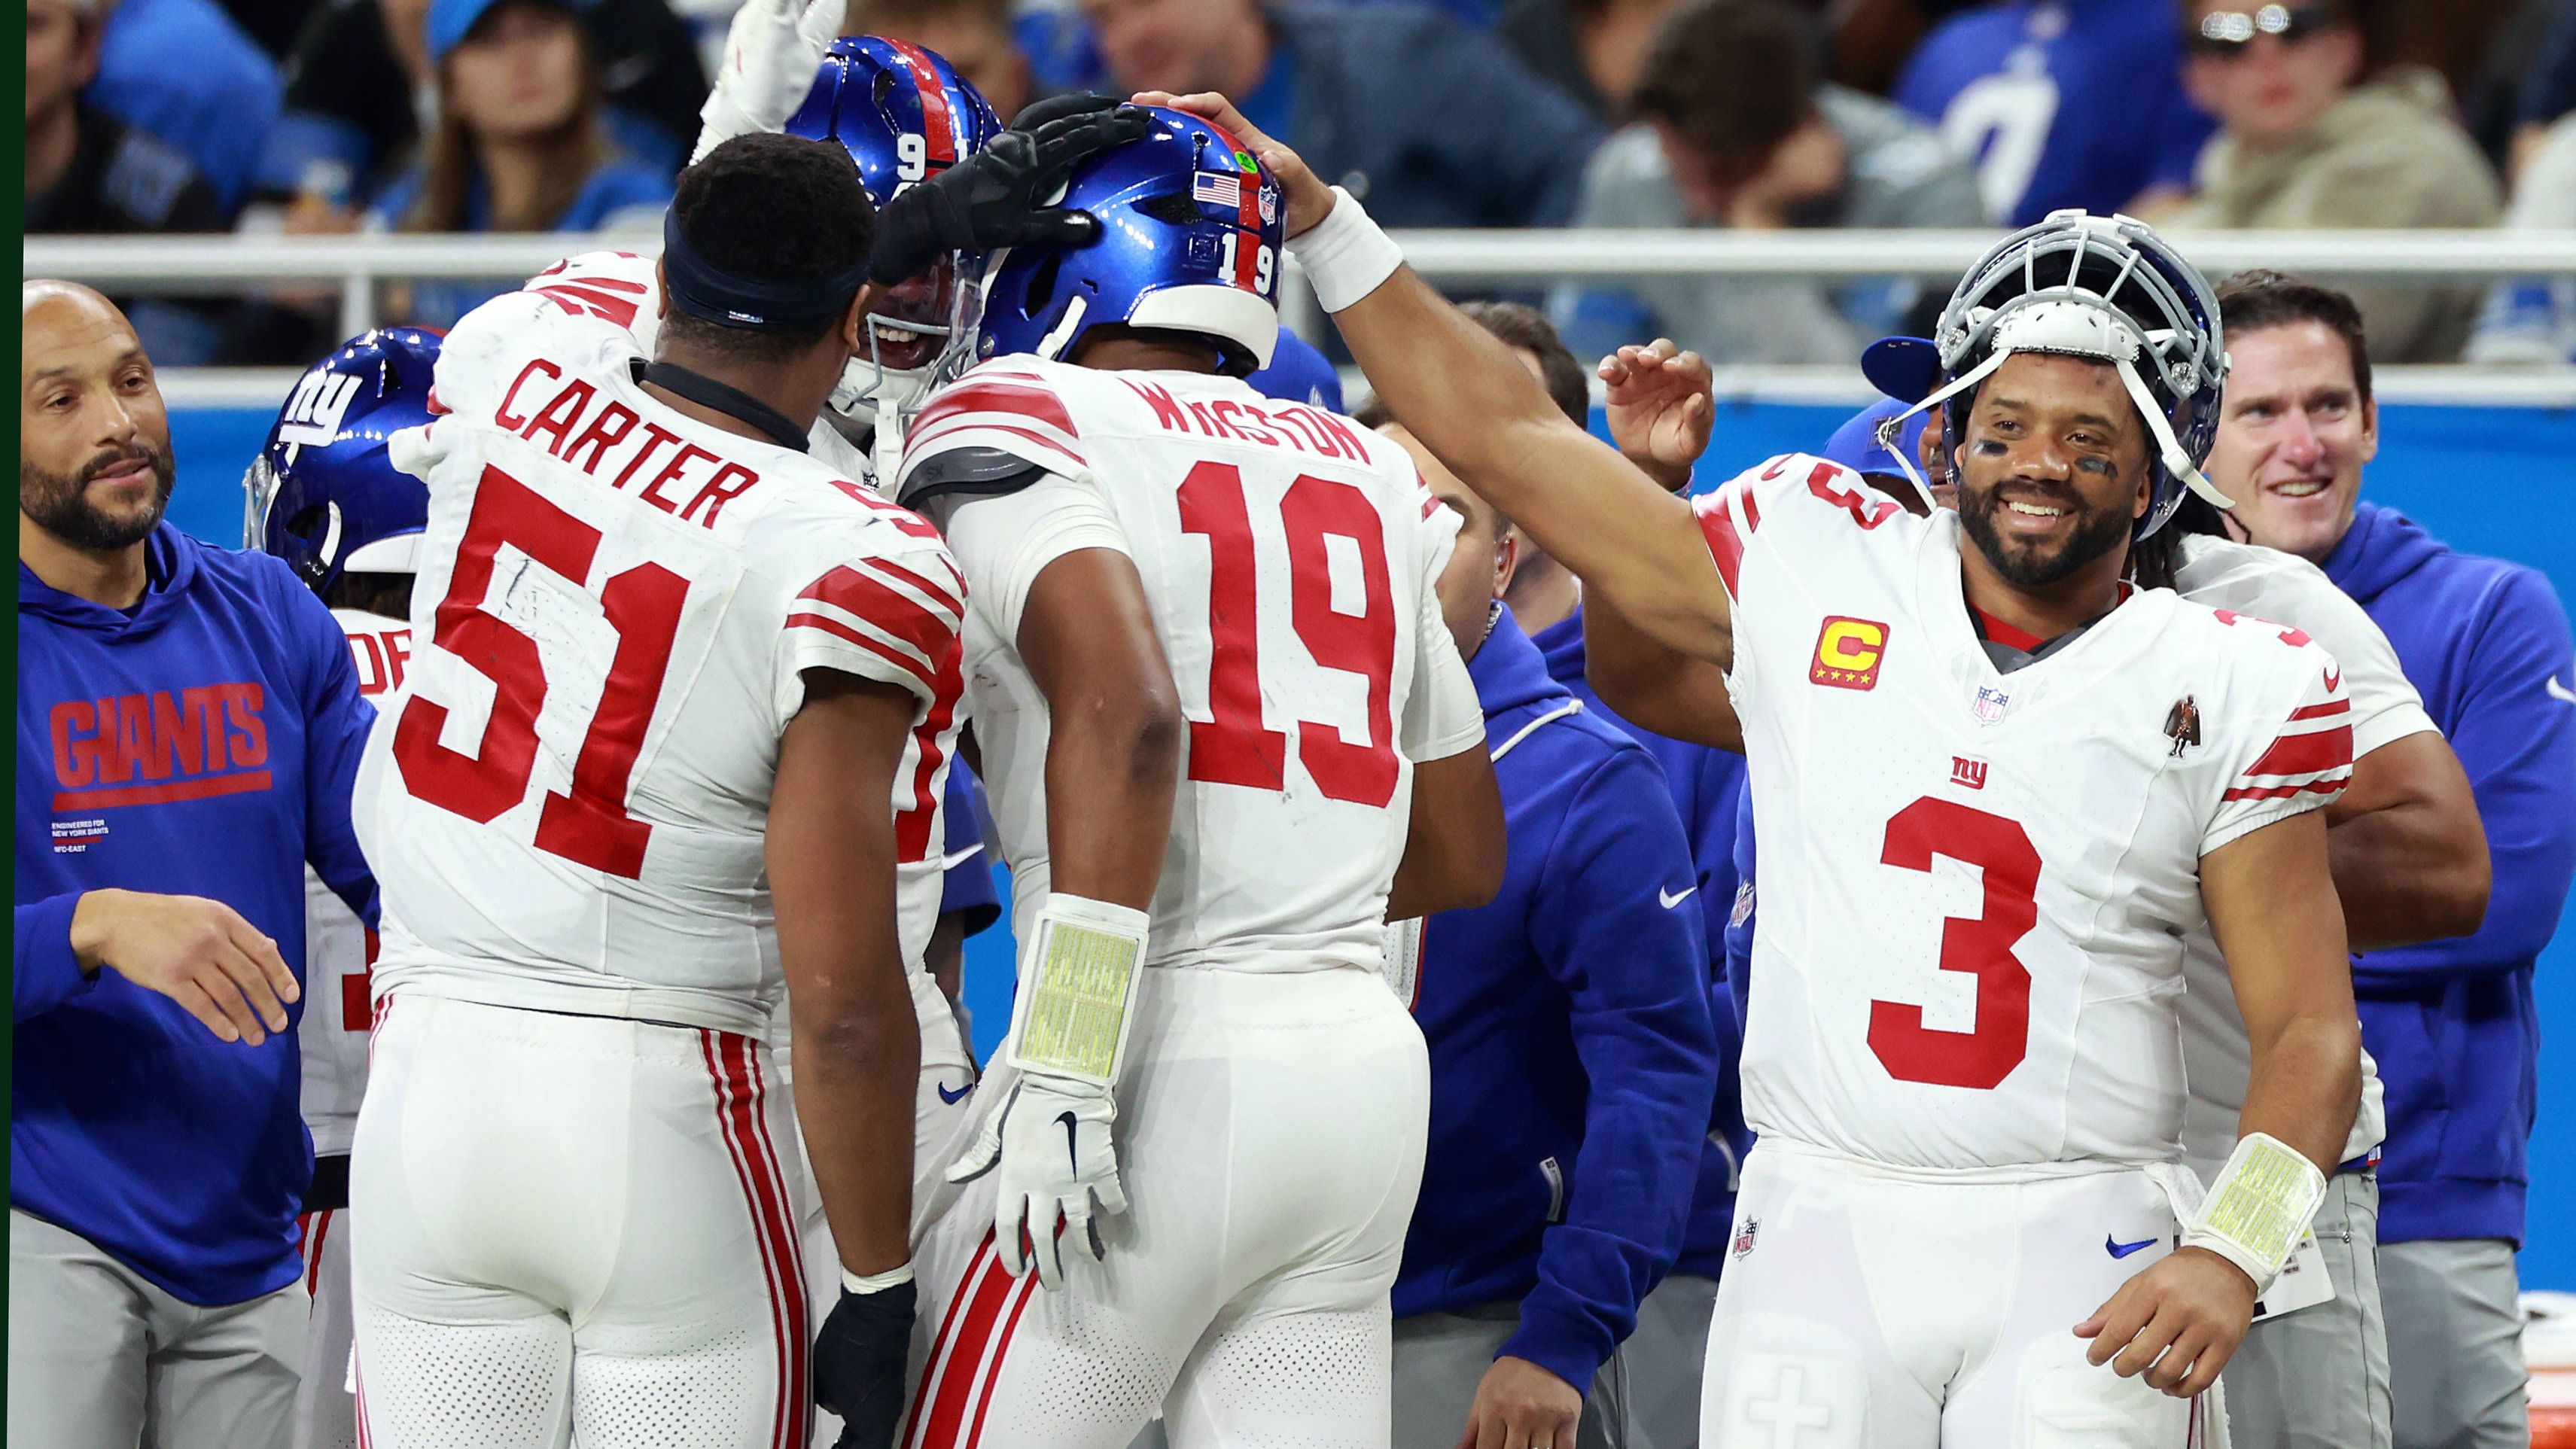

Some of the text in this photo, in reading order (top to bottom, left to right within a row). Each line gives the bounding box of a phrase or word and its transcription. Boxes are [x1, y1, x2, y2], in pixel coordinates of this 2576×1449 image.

[1218, 233, 1274, 295] 19
[495, 358, 760, 530] CARTER
[1118, 377, 1372, 466] WINSTON
[392, 462, 691, 880] 51
[1177, 460, 1399, 808] 19
[1819, 619, 1882, 671] C
[50, 682, 269, 788] GIANTS
[87, 827, 108, 836] GIANTS
[93, 819, 105, 827] FOR
[1868, 796, 2042, 1090] 3
